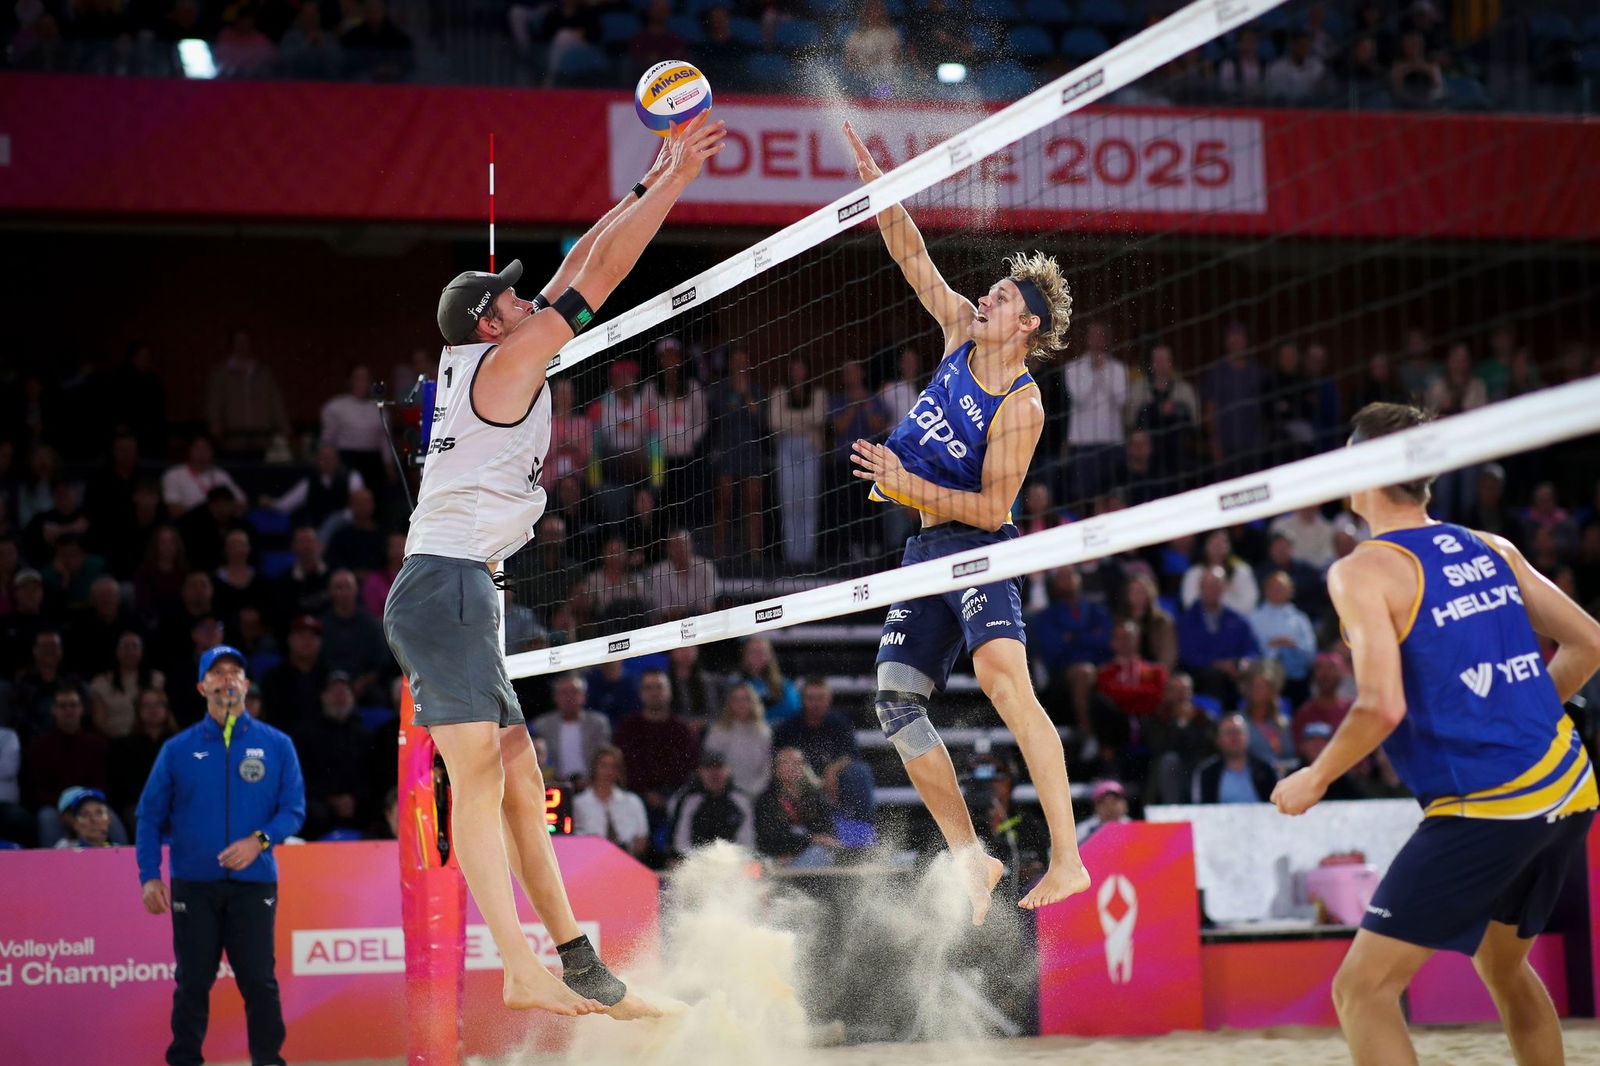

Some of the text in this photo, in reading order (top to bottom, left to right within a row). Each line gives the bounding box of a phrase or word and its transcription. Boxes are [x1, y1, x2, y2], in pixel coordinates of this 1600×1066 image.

[1046, 135, 1235, 188] 2025
[475, 291, 492, 313] BNEW
[444, 366, 453, 388] 1
[1433, 534, 1464, 554] 2
[1442, 555, 1497, 587] SWE
[1496, 652, 1540, 684] YET
[0, 937, 95, 960] Volleyball
[306, 935, 485, 964] ADELE
